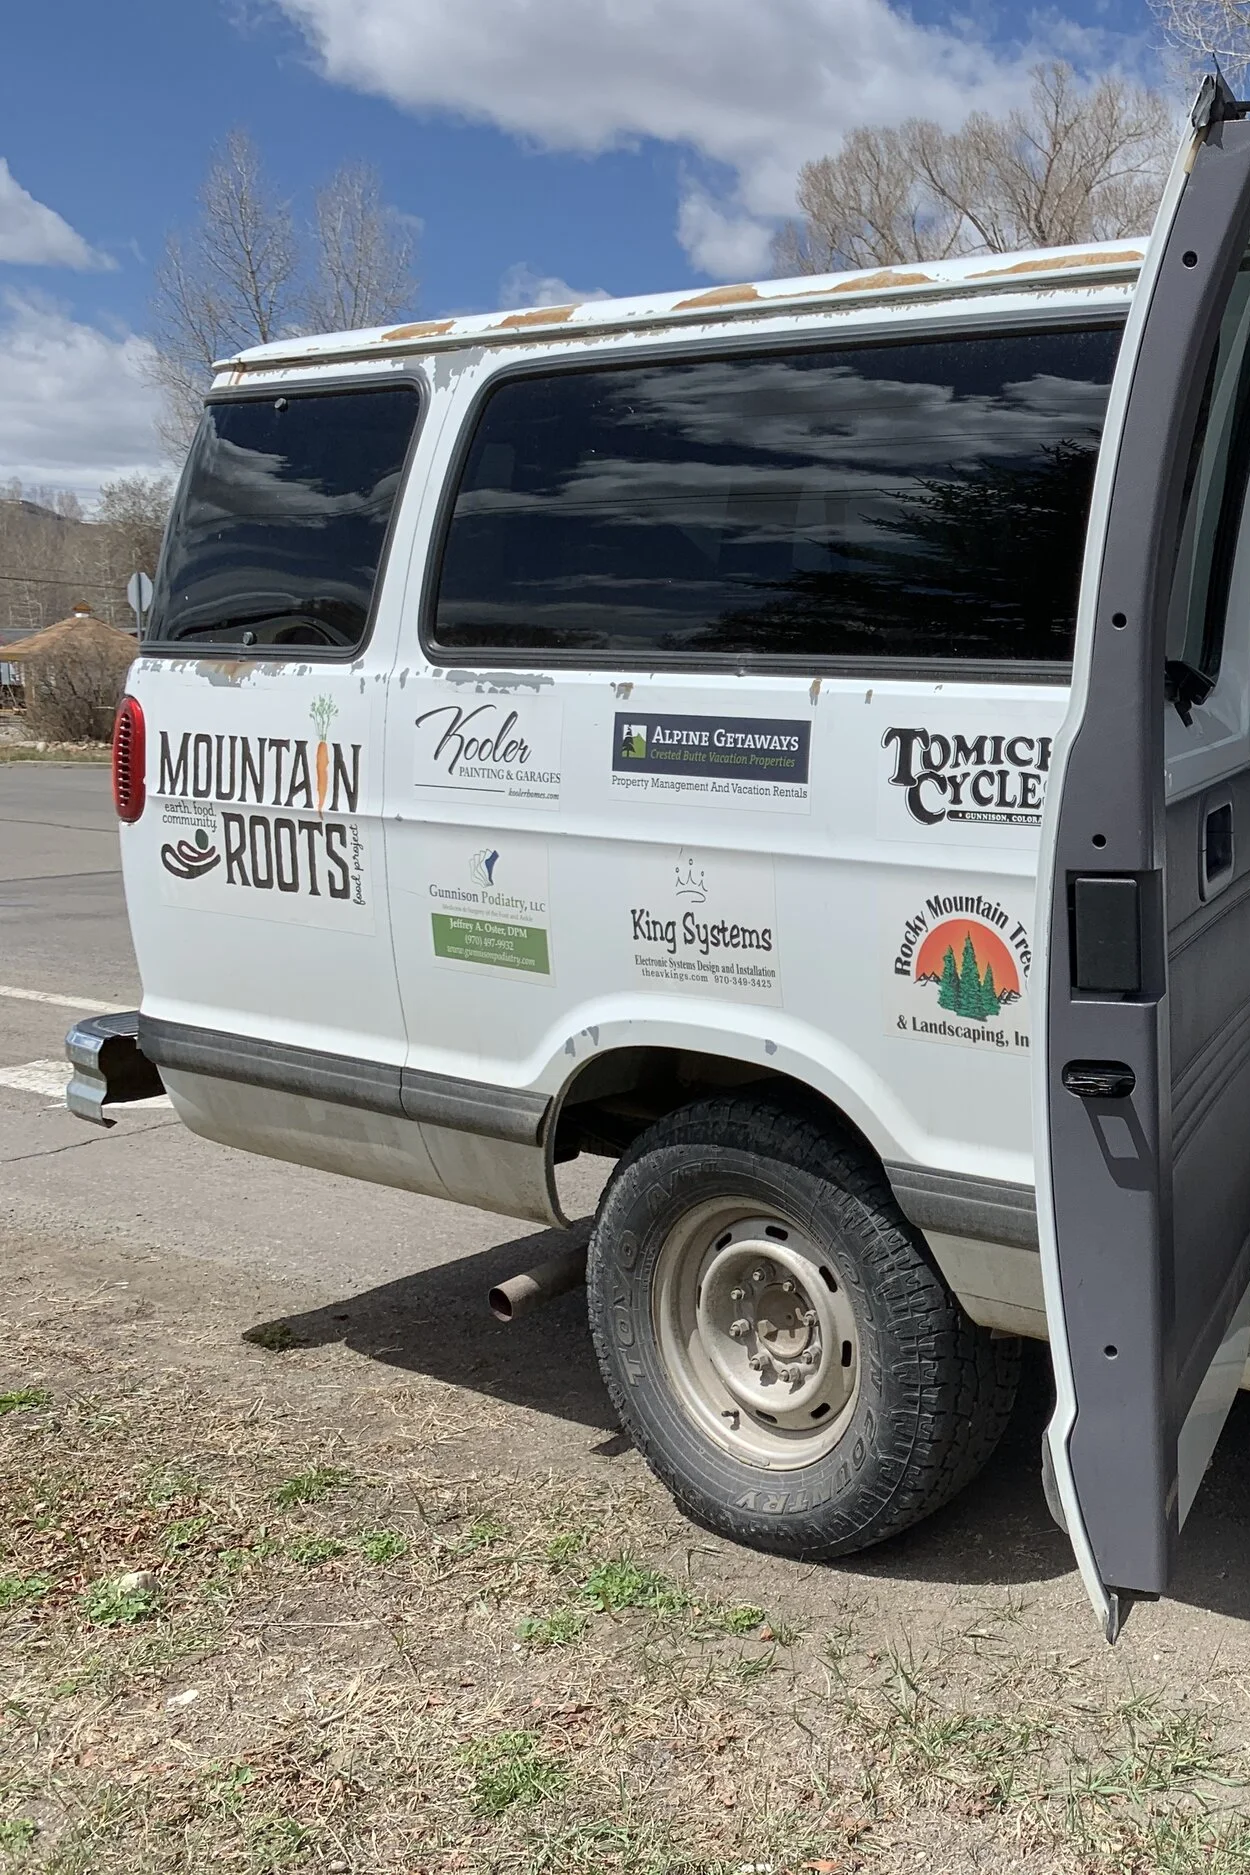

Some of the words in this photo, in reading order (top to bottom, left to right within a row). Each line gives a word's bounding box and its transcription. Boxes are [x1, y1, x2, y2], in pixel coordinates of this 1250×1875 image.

[415, 704, 532, 775] Kooler
[652, 726, 709, 746] ALPINE
[713, 729, 799, 751] GETAWAYS
[651, 749, 682, 761] Crested
[683, 751, 706, 762] Butte
[709, 752, 747, 765] Vacation
[750, 755, 795, 769] Properties
[881, 727, 1053, 787] TOMICH
[157, 731, 362, 816] MOUNTAIN
[459, 766, 504, 780] PAINTING
[506, 769, 514, 780] &
[516, 770, 561, 784] GARAGES
[611, 775, 649, 789] Property
[651, 777, 709, 792] Management
[711, 781, 730, 793] And
[731, 783, 771, 796] Vacation
[773, 786, 807, 798] Rentals
[165, 800, 192, 814] earth.
[193, 801, 217, 816] food.
[905, 769, 1047, 825] CYCLE
[162, 814, 217, 832] community.
[965, 812, 1010, 823] GUNNISON,
[1011, 815, 1042, 824] COLORA
[222, 812, 352, 900] ROOTS
[349, 823, 364, 871] project
[350, 874, 366, 905] food
[429, 884, 479, 903] Gunnison
[481, 891, 528, 913] Podiatry,
[530, 901, 546, 912] LLC
[449, 918, 474, 933] Jeffrey
[475, 921, 483, 932] A.
[484, 923, 506, 936] Oster,
[507, 926, 528, 938] DPM
[465, 934, 482, 946] (970)
[630, 908, 677, 954] King
[682, 912, 773, 955] Systems
[894, 911, 929, 977] Rocky
[925, 894, 1009, 930] Mountain
[634, 954, 668, 968] Electronic
[668, 957, 696, 971] Systems
[697, 960, 720, 975] Design
[721, 963, 735, 973] and
[736, 964, 776, 978] Installation
[642, 968, 708, 982] theavkings.com
[897, 1015, 907, 1029] &
[912, 1016, 1009, 1047] Landscaping,
[1014, 1031, 1029, 1048] In
[611, 1229, 645, 1388] TOYO
